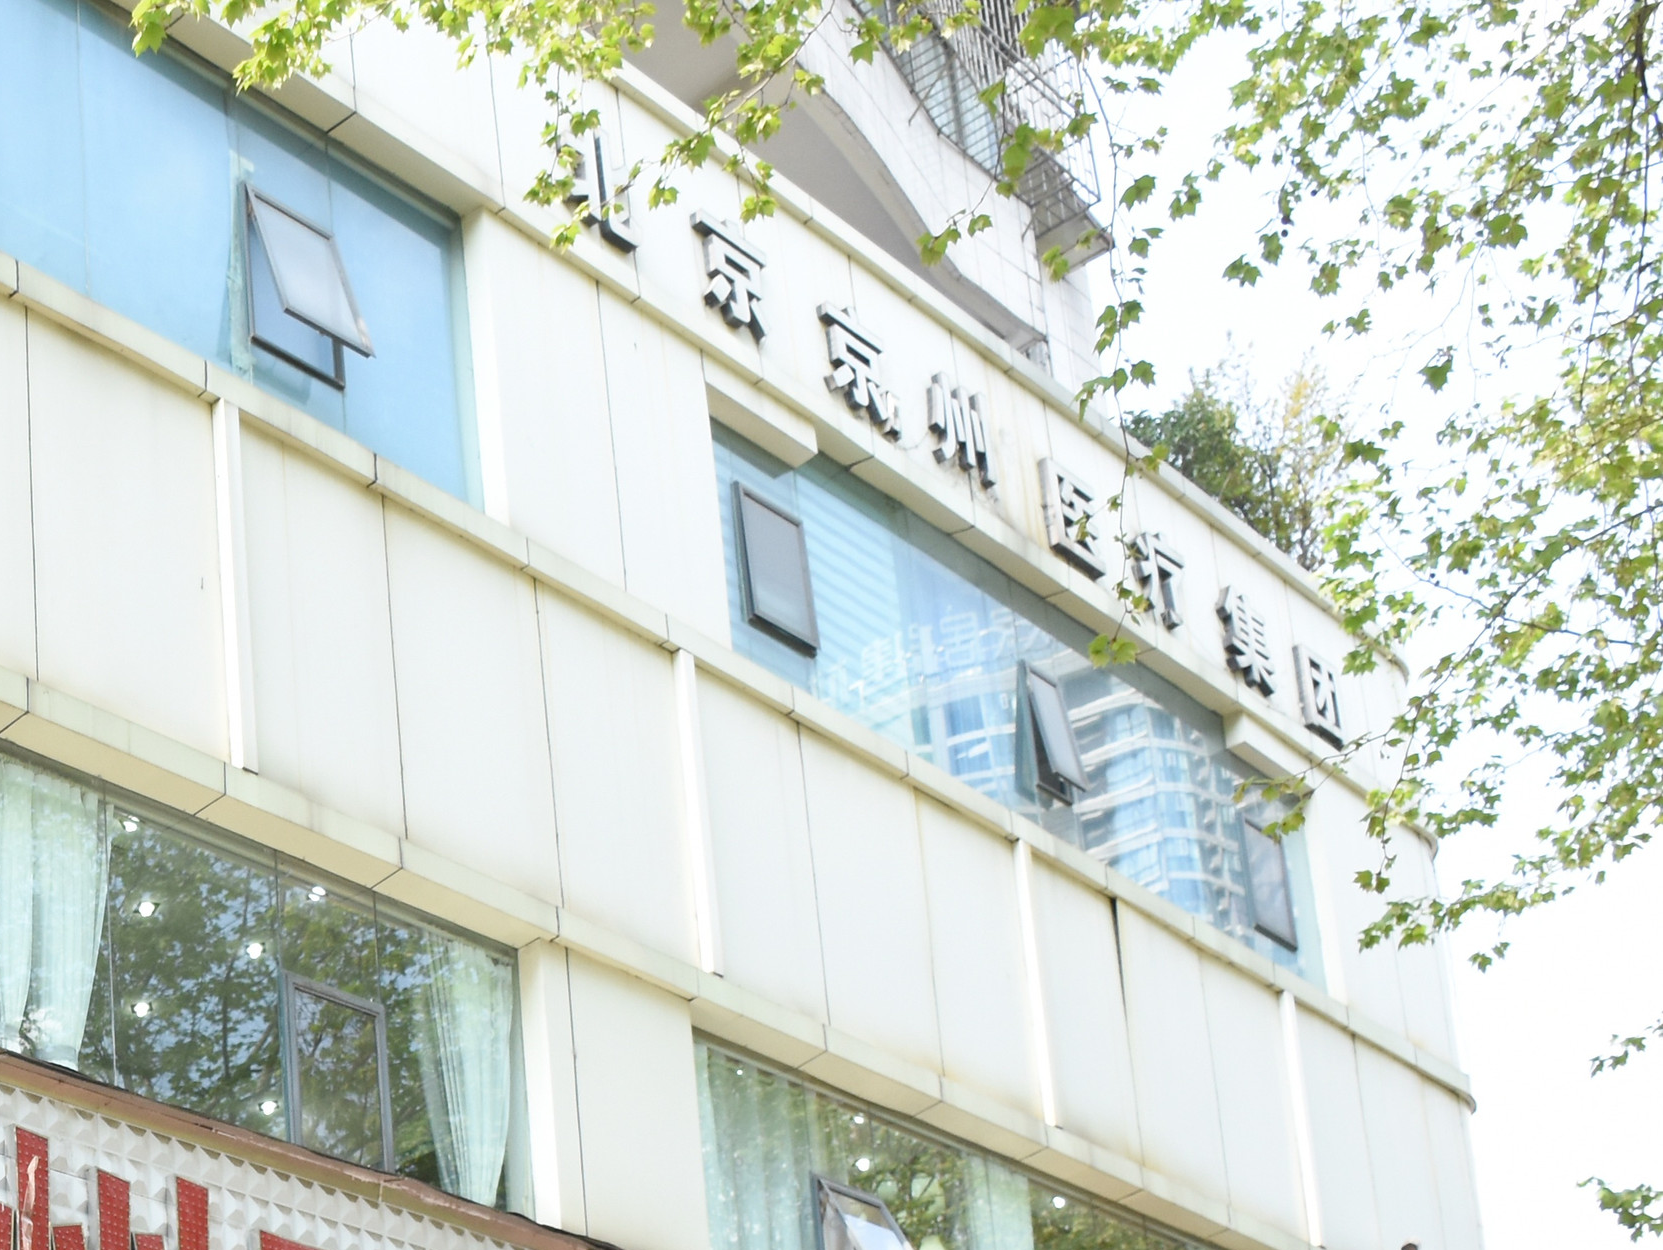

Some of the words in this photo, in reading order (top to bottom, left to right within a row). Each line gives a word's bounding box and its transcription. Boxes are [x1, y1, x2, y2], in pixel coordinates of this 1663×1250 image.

[559, 126, 1345, 748] 北京京州医疗集团
